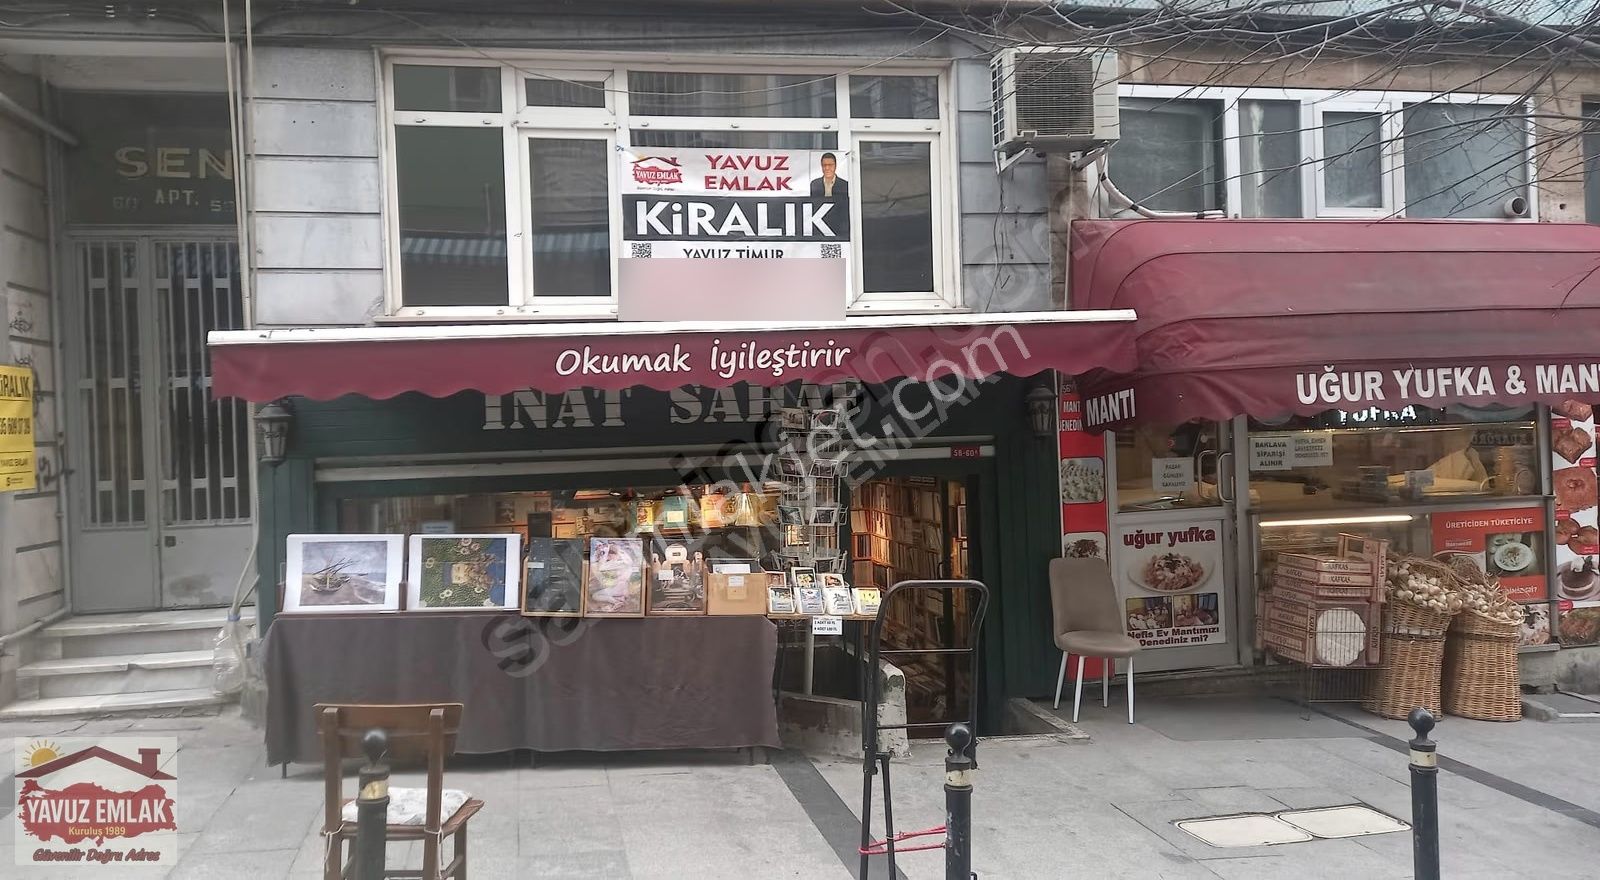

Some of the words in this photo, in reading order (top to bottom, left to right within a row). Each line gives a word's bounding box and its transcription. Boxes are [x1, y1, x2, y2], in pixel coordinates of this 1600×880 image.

[115, 146, 233, 180] SEN
[705, 154, 789, 171] YAVUZ
[636, 170, 656, 180] YAVUZ
[656, 171, 680, 180] EMLAK
[704, 175, 793, 191] EMLAK
[155, 189, 199, 206] APT.
[682, 248, 731, 258] YAVUZ
[735, 246, 784, 258] TİMUR
[555, 345, 692, 376] Okumak
[710, 339, 851, 379] İyileştirir
[1296, 364, 1384, 405] UĞUR
[1392, 365, 1496, 399] YUFKA
[1504, 365, 1527, 395] &
[1535, 363, 1600, 394] MAN
[1086, 388, 1136, 427] MANTI
[1445, 519, 1489, 529] ÜRETİCİDEN
[1491, 517, 1533, 526] TÜKETİCİYE
[1123, 529, 1164, 549] uğur
[1167, 526, 1216, 547] yufka
[1157, 629, 1169, 637] Ev
[1172, 626, 1219, 636] Mantımızı
[1140, 636, 1188, 647] Denediniz
[1191, 634, 1209, 644] mi?
